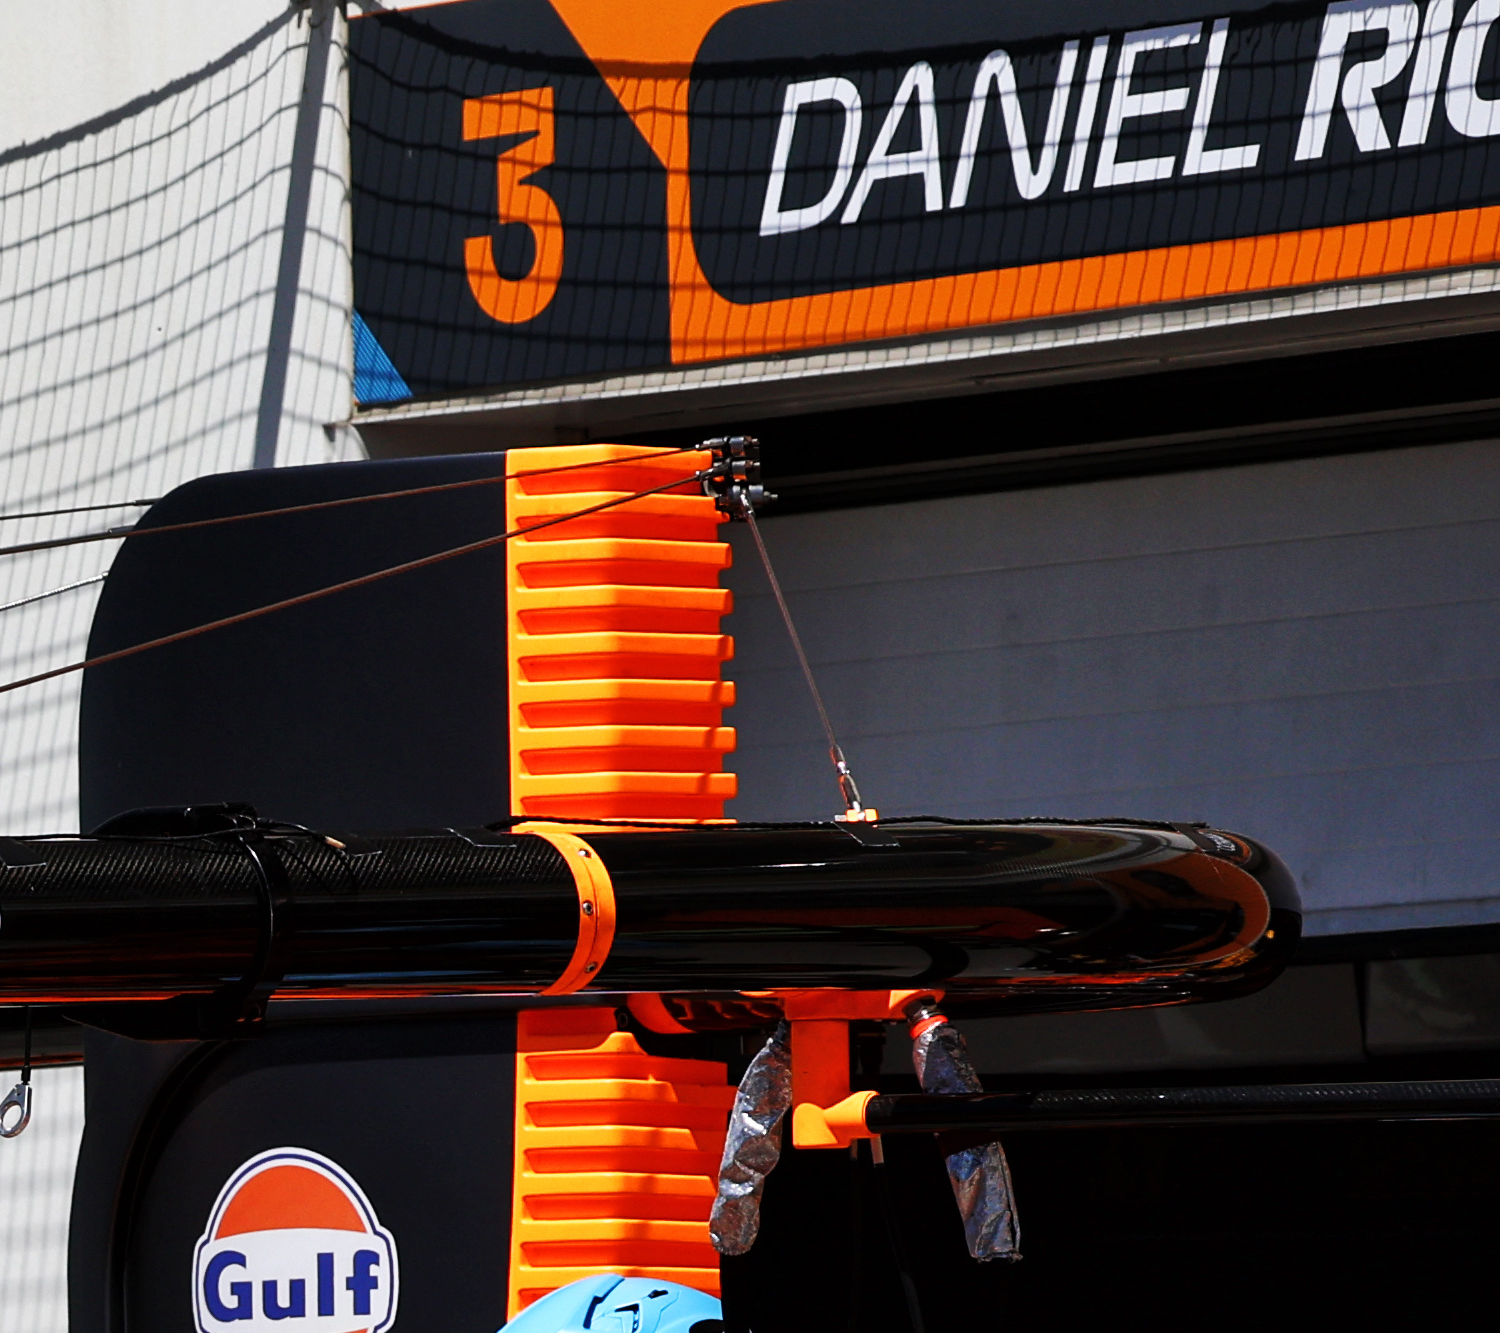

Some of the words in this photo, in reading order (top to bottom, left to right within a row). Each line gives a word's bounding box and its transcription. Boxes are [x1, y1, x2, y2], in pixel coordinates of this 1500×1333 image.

[462, 86, 564, 323] 3
[758, 17, 1263, 237] DANIEL
[202, 1248, 382, 1321] Gulf
